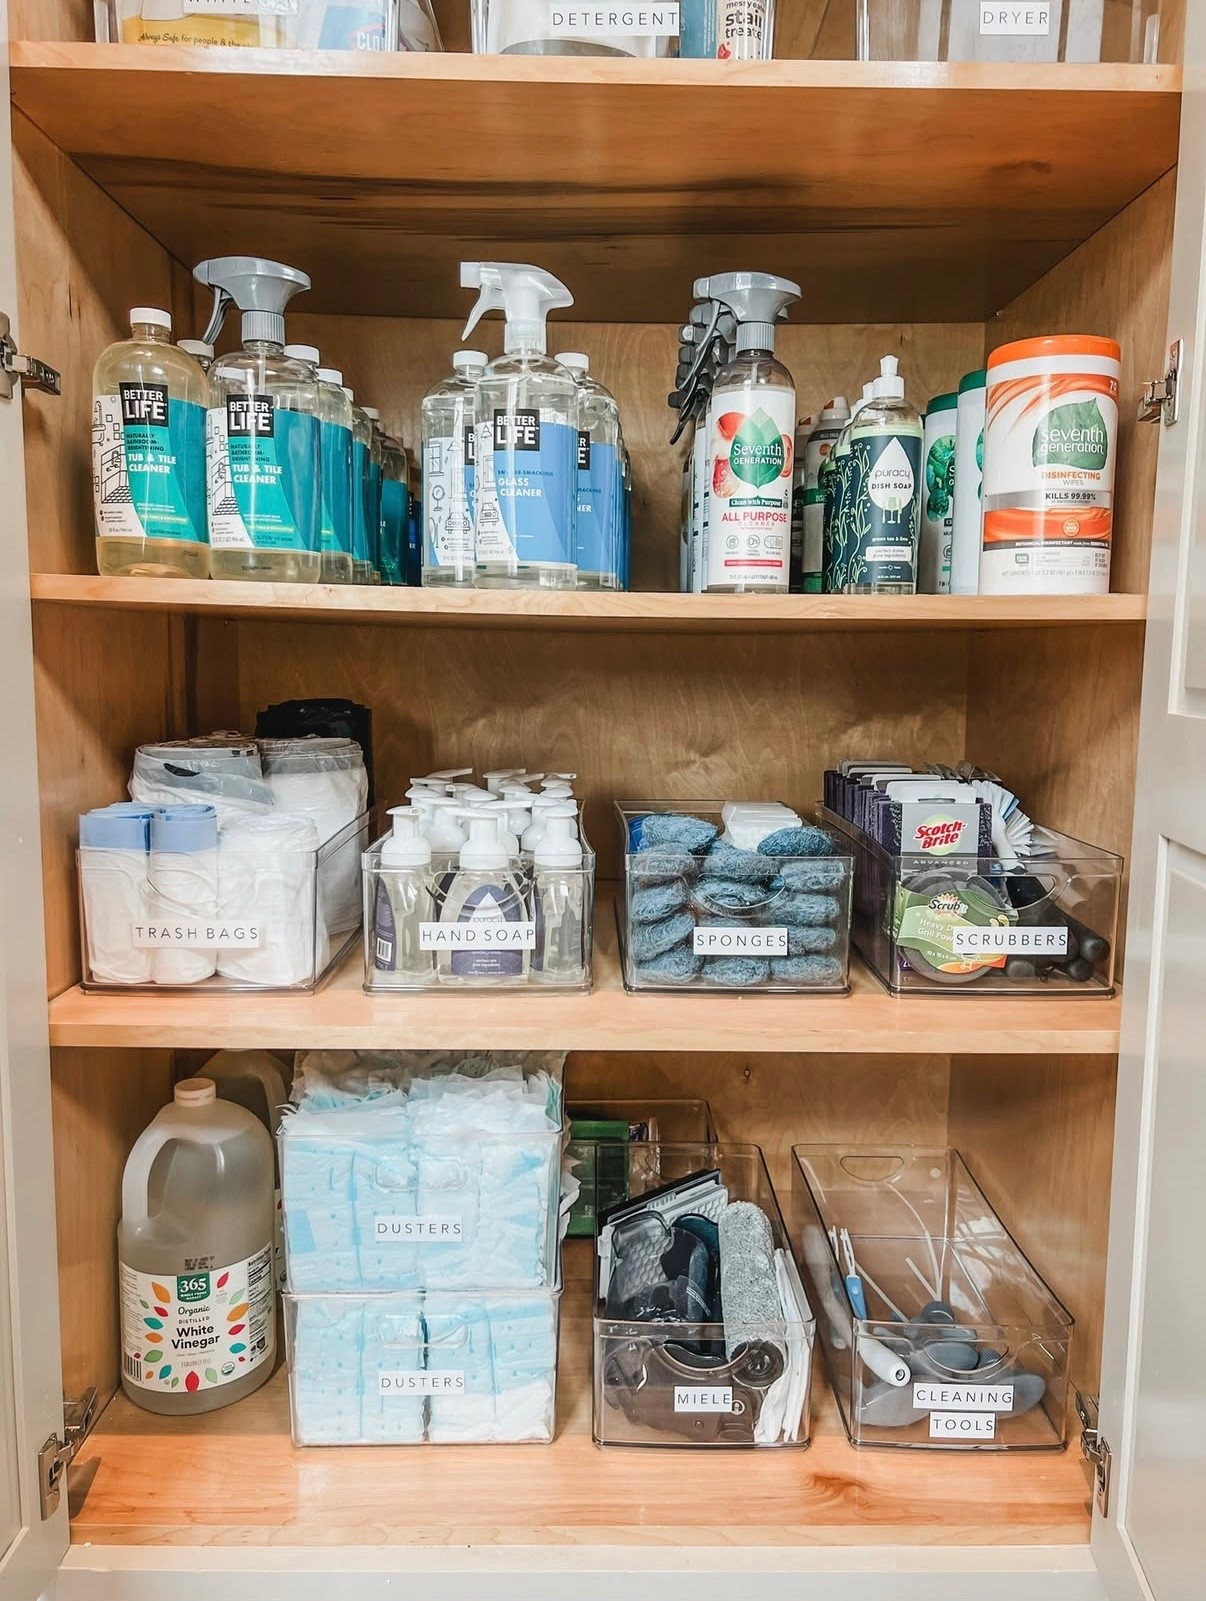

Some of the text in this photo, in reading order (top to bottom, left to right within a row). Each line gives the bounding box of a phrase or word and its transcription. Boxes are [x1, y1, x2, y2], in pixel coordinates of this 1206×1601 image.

[552, 12, 678, 26] DETERGENT
[983, 12, 1048, 25] DRYER
[162, 32, 180, 43] Safe
[181, 34, 191, 42] for
[193, 36, 218, 46] people
[219, 38, 227, 46] &
[123, 389, 164, 401] BETTER
[125, 400, 166, 420] LIFE
[230, 412, 272, 432] LIFE
[497, 415, 536, 426] BETTER
[497, 426, 539, 445] LIFE
[1041, 424, 1104, 443] seventh
[733, 443, 782, 457] Seventh
[1041, 441, 1104, 455] generation
[128, 453, 144, 463] TUB
[158, 455, 177, 465] TILE
[733, 456, 782, 466] GENERATION
[129, 464, 171, 474] CLEANER
[232, 464, 250, 473] TUB
[264, 466, 283, 475] TILE
[875, 470, 911, 480] puracy
[1042, 471, 1101, 480] DISINFECTING
[233, 475, 276, 485] CLEANER
[498, 478, 529, 487] GLASS
[893, 482, 913, 490] SOAP
[500, 488, 542, 498] CLEANER
[1071, 492, 1096, 501] 99.99%
[722, 511, 788, 524] ALL PURPOSE
[915, 820, 967, 840] Scotch-
[920, 832, 960, 850] Brite
[928, 899, 961, 911] Scrub
[919, 918, 945, 931] Heavy
[135, 926, 258, 939] TRASH BAGS
[422, 929, 535, 942] HAND SOAP
[917, 927, 935, 937] Grill
[697, 934, 786, 947] SPONGES
[956, 933, 1067, 946] SCRUBBERS
[377, 1223, 461, 1234] DUSTERS
[180, 1278, 207, 1293] 365
[178, 1305, 210, 1316] Organic
[178, 1316, 210, 1324] DISTILLED
[176, 1325, 214, 1338] White
[171, 1335, 220, 1350] Vinegar
[381, 1377, 463, 1388] DUSTERS
[677, 1393, 730, 1404] MIELE
[916, 1389, 1012, 1404] CLEANING
[933, 1418, 994, 1431] TOOLS
